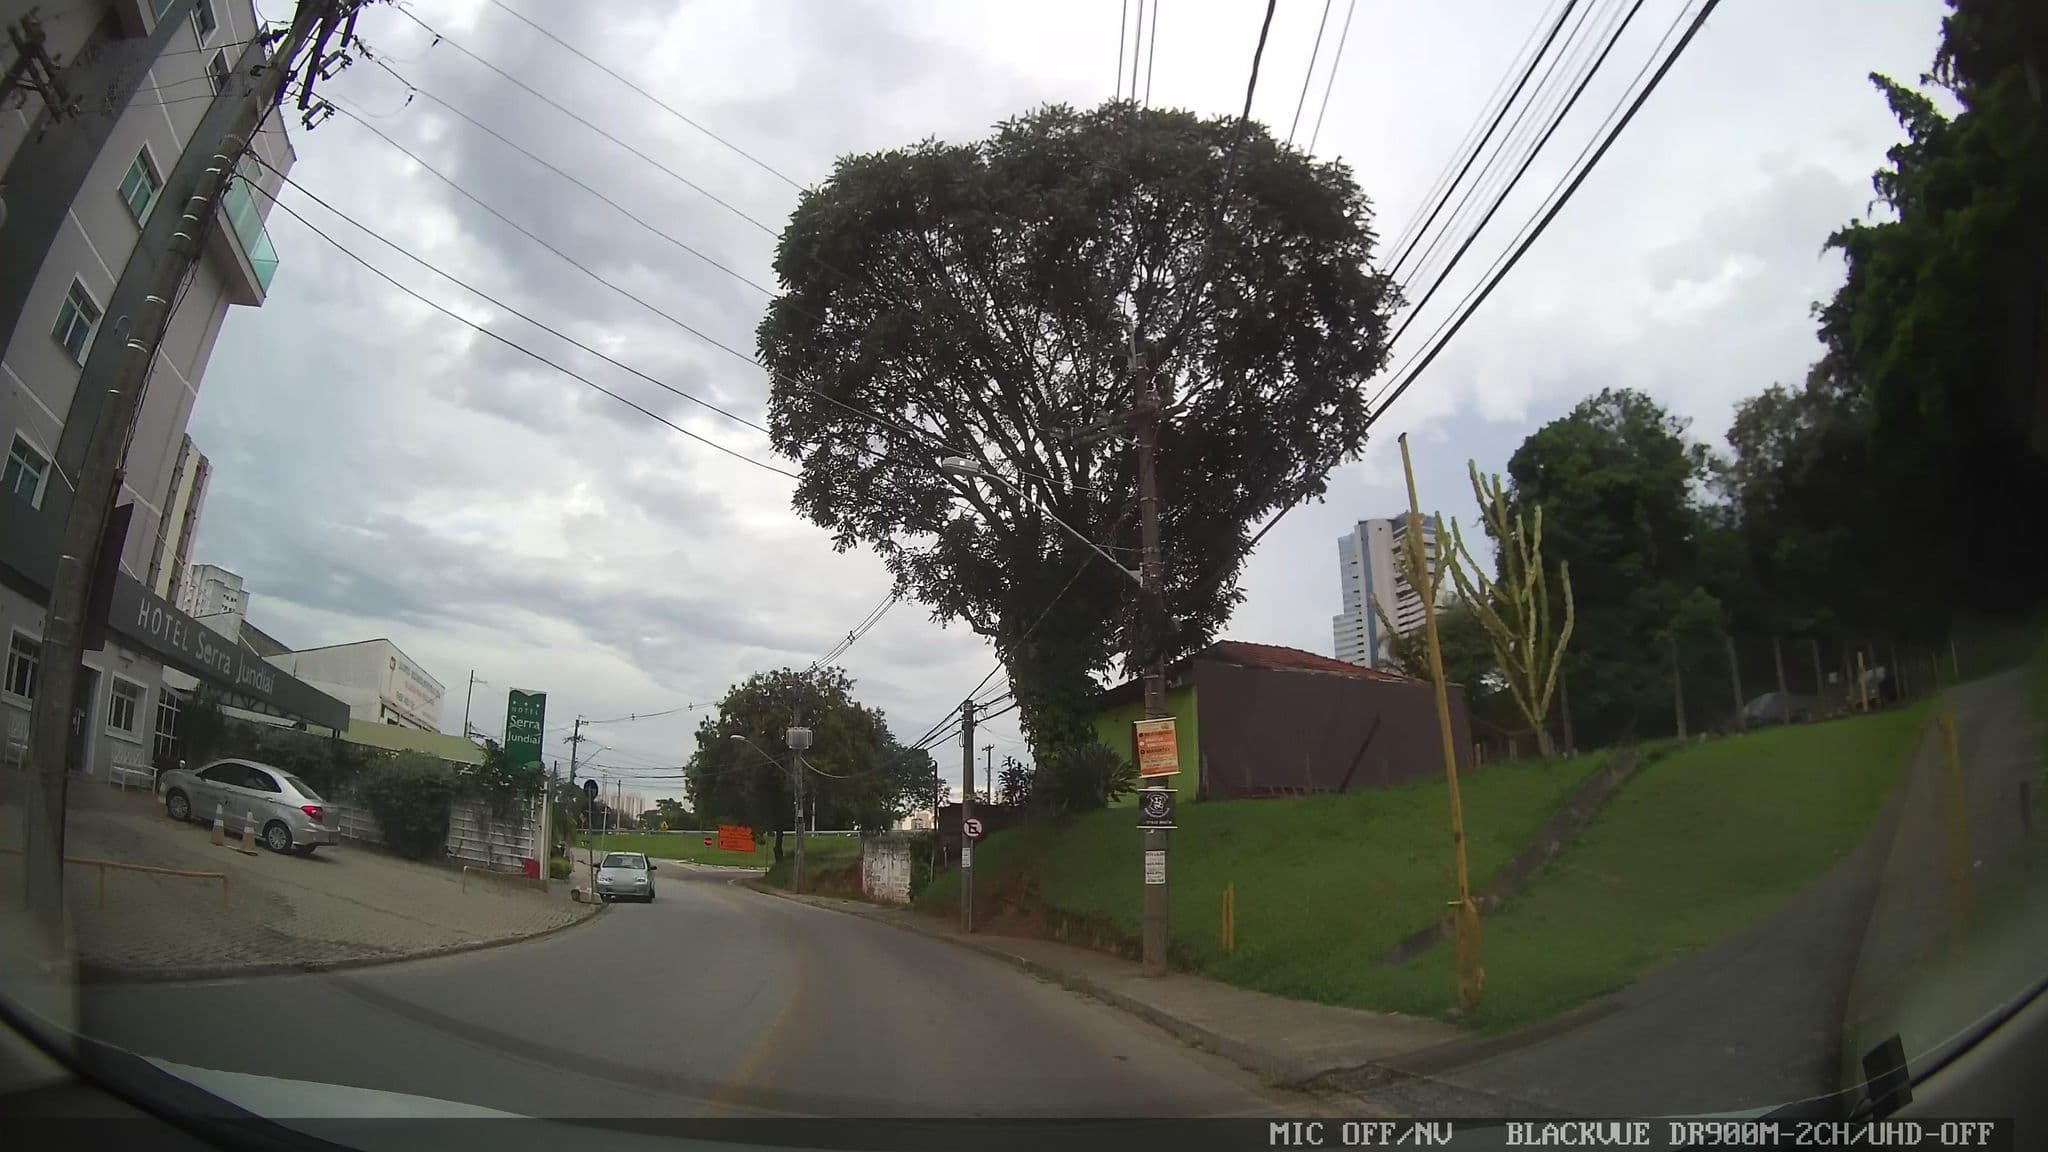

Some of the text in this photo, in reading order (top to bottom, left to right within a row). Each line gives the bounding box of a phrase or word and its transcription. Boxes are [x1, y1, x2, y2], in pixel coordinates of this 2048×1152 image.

[138, 598, 188, 651] HOTEL
[196, 631, 231, 675] Serra
[512, 706, 538, 716] HOTEL
[510, 715, 540, 729] Serra
